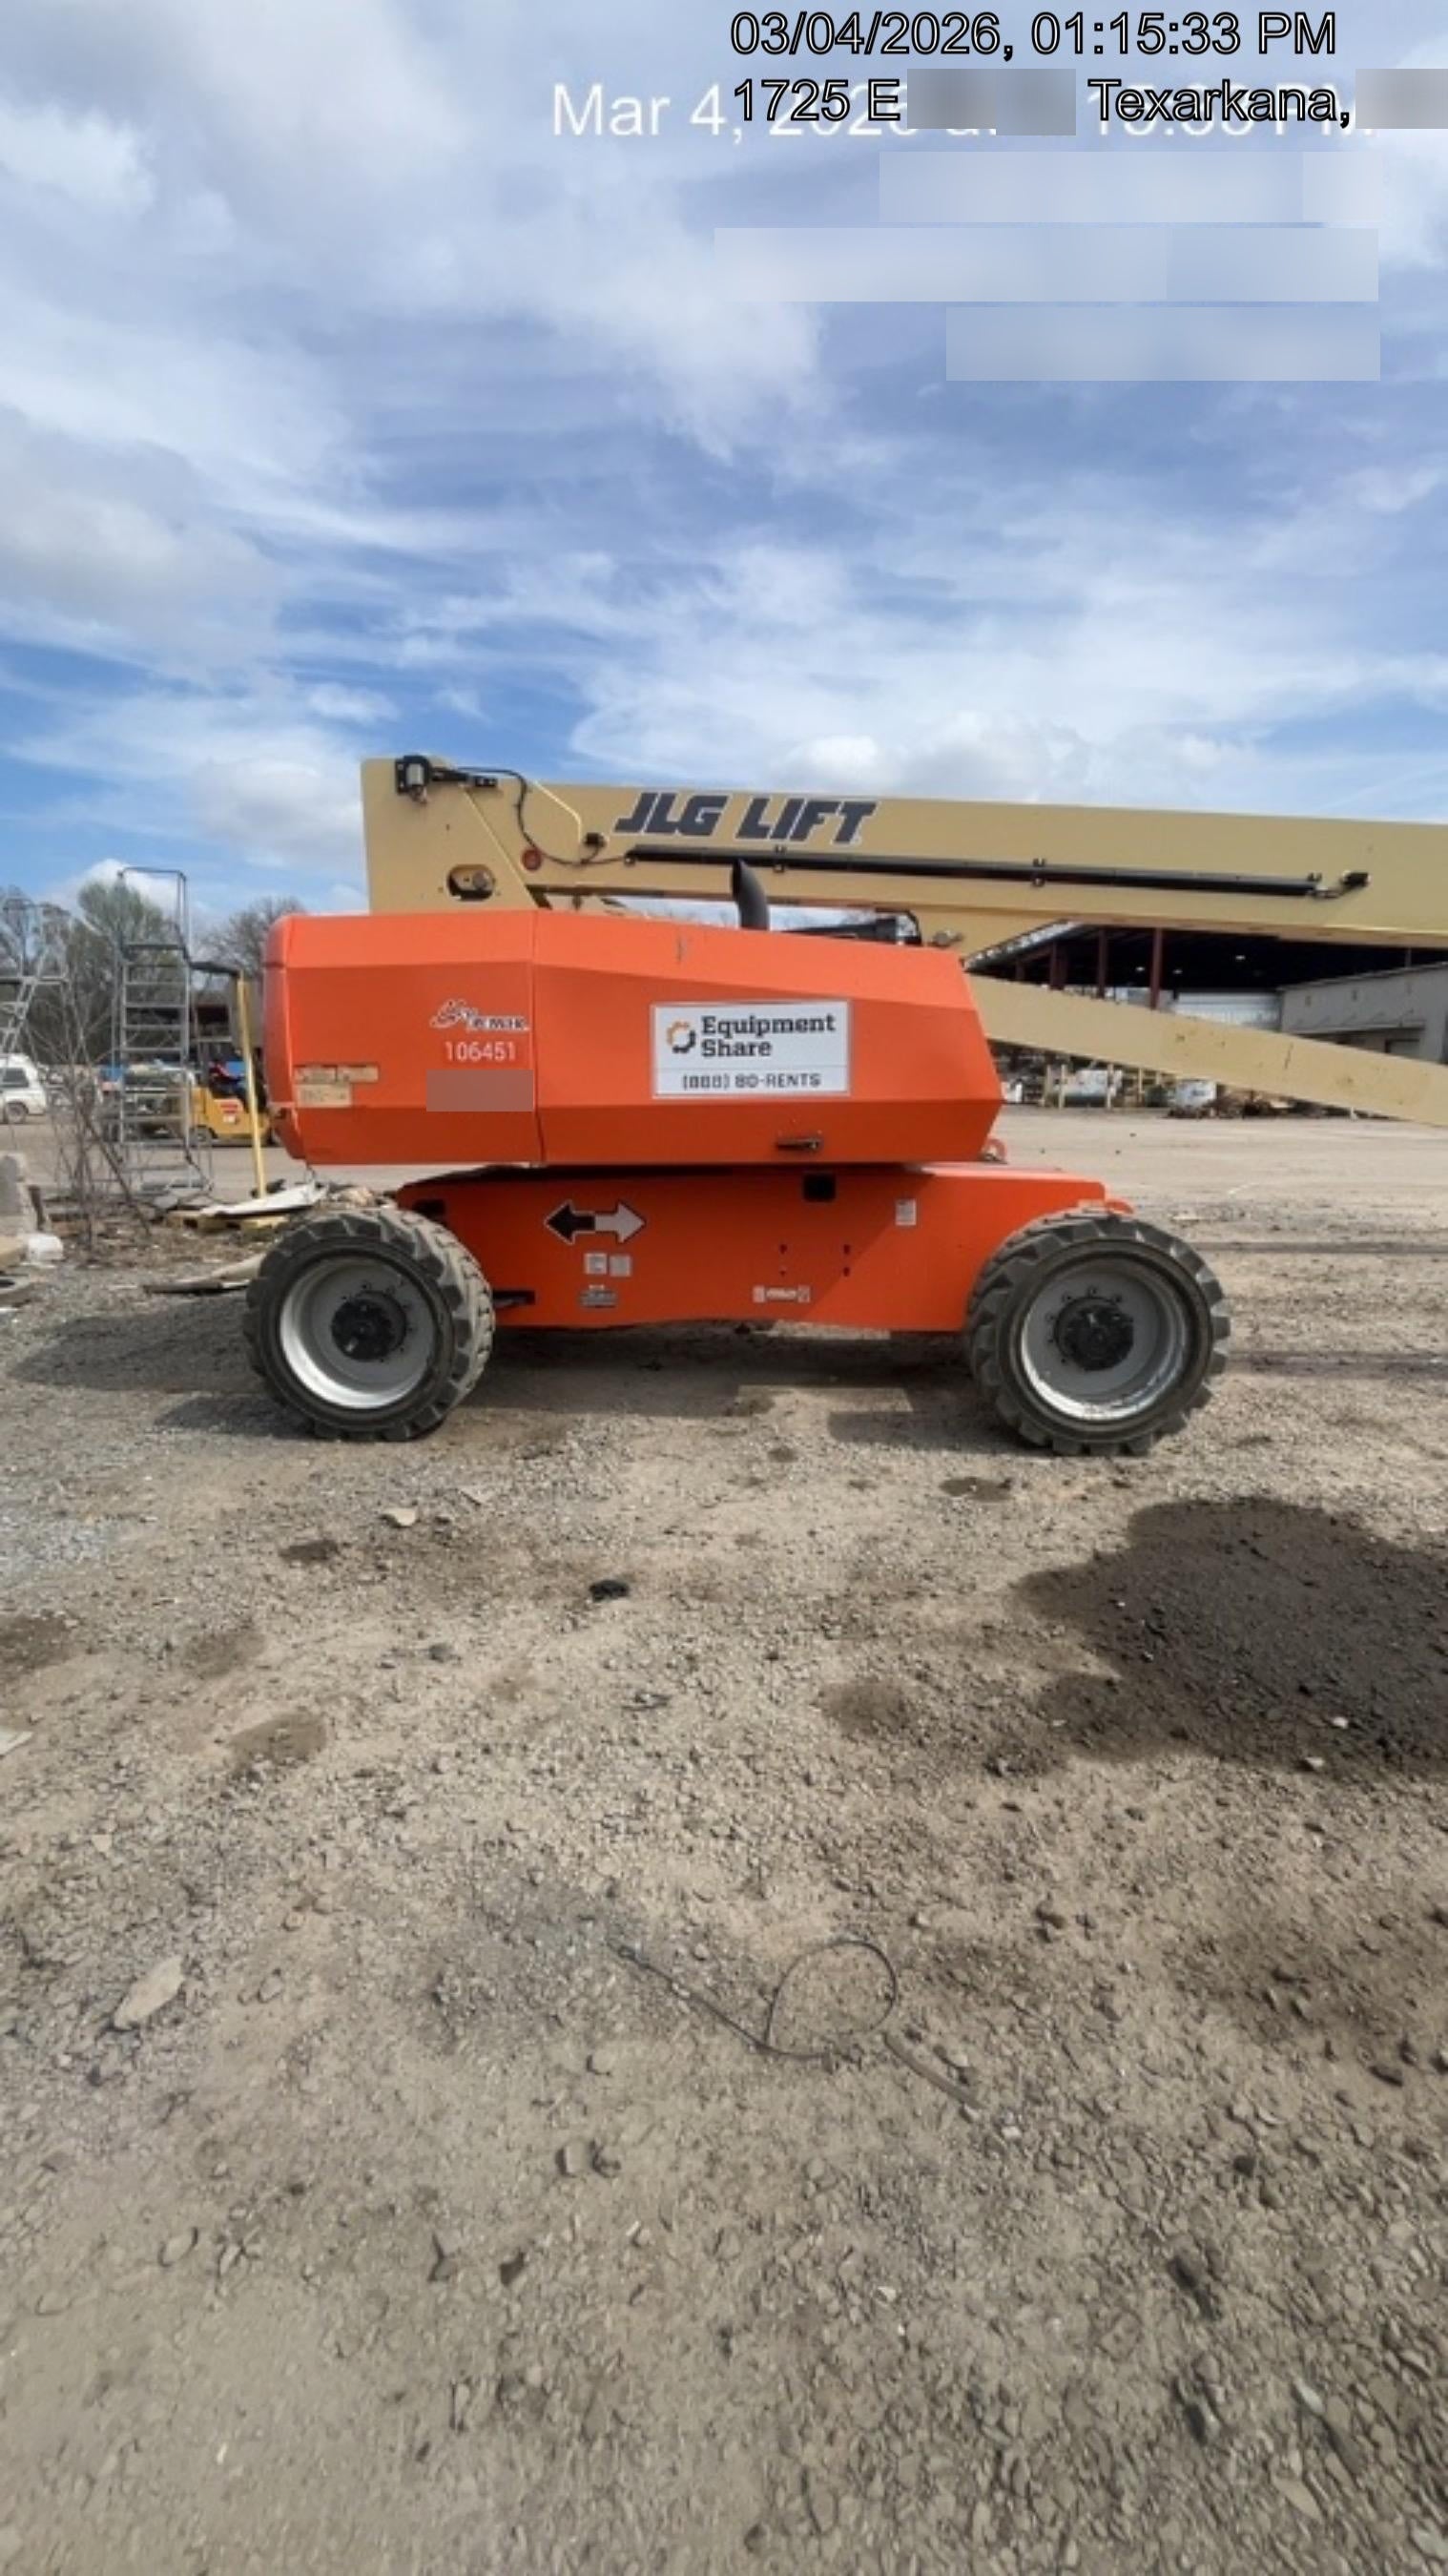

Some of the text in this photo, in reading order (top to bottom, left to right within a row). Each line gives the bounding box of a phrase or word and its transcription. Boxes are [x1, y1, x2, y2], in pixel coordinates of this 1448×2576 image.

[613, 792, 877, 844] JLG LIFT
[701, 1014, 836, 1038] Equipment
[445, 1041, 516, 1061] 106451
[701, 1039, 772, 1057] Share
